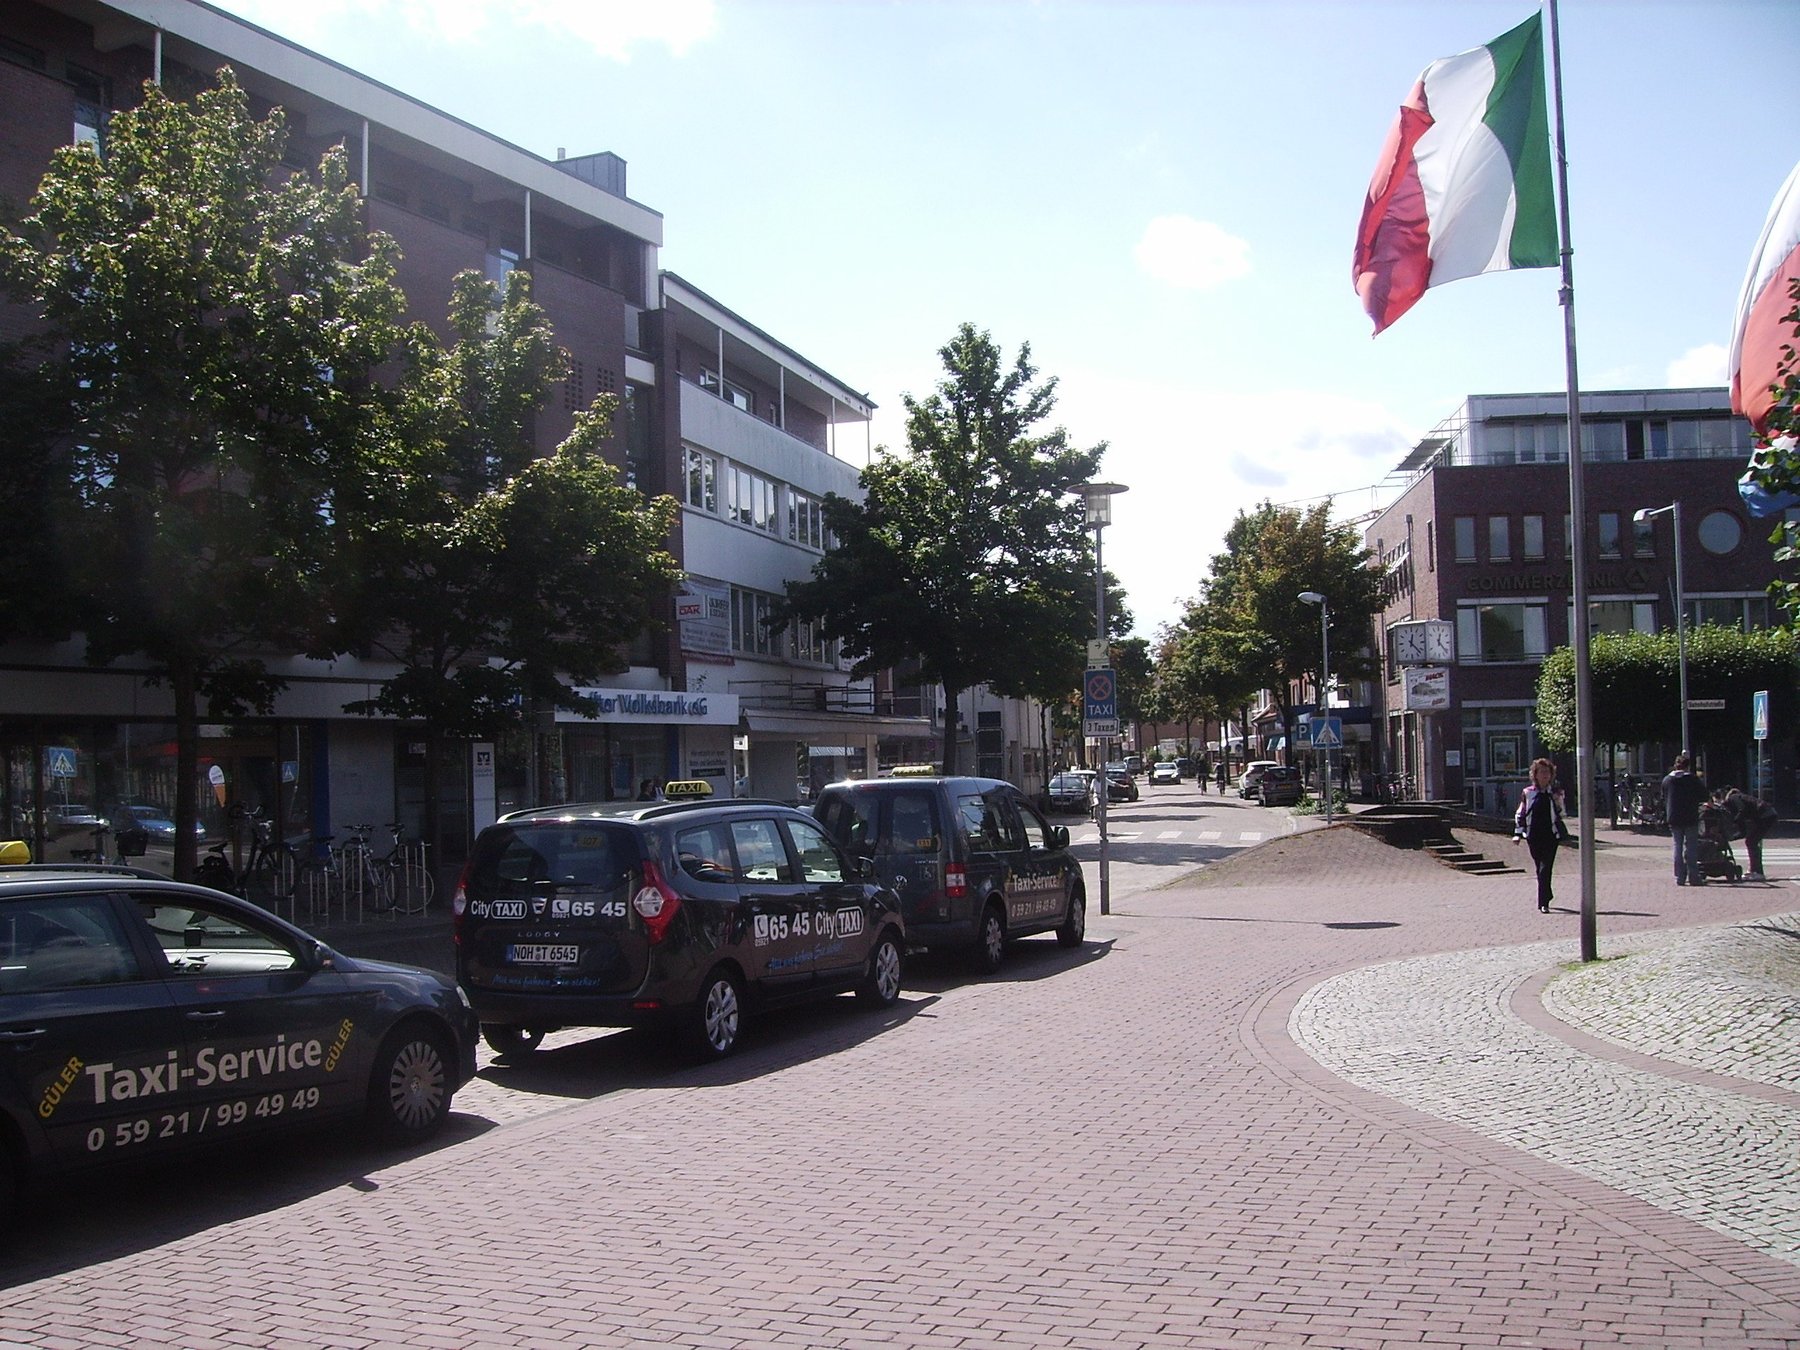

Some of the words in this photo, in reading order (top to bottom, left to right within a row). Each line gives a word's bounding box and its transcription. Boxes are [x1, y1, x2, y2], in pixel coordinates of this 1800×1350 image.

[1088, 704, 1113, 715] TAXI
[1087, 722, 1093, 732] 3
[1299, 725, 1308, 738] P
[672, 783, 701, 793] TAXI
[1012, 871, 1057, 892] Taxi-Service
[471, 900, 491, 918] City
[495, 902, 523, 916] TAXI
[571, 902, 595, 916] 65
[600, 902, 626, 917] 45
[770, 914, 789, 941] 65
[792, 911, 810, 936] 45
[815, 911, 835, 939] City
[838, 910, 861, 934] TAXI
[514, 946, 534, 960] NOH
[541, 947, 548, 960] T
[550, 947, 577, 961] 6545
[325, 1018, 355, 1073] GÜLER
[85, 1034, 322, 1105] Taxi-Service
[38, 1055, 85, 1119] GÜLER
[87, 1127, 105, 1151] 0
[115, 1119, 150, 1146] 59
[159, 1112, 189, 1138] 21
[198, 1107, 210, 1133] /
[217, 1101, 248, 1127] 99
[255, 1093, 285, 1118] 49
[291, 1086, 321, 1110] 49
